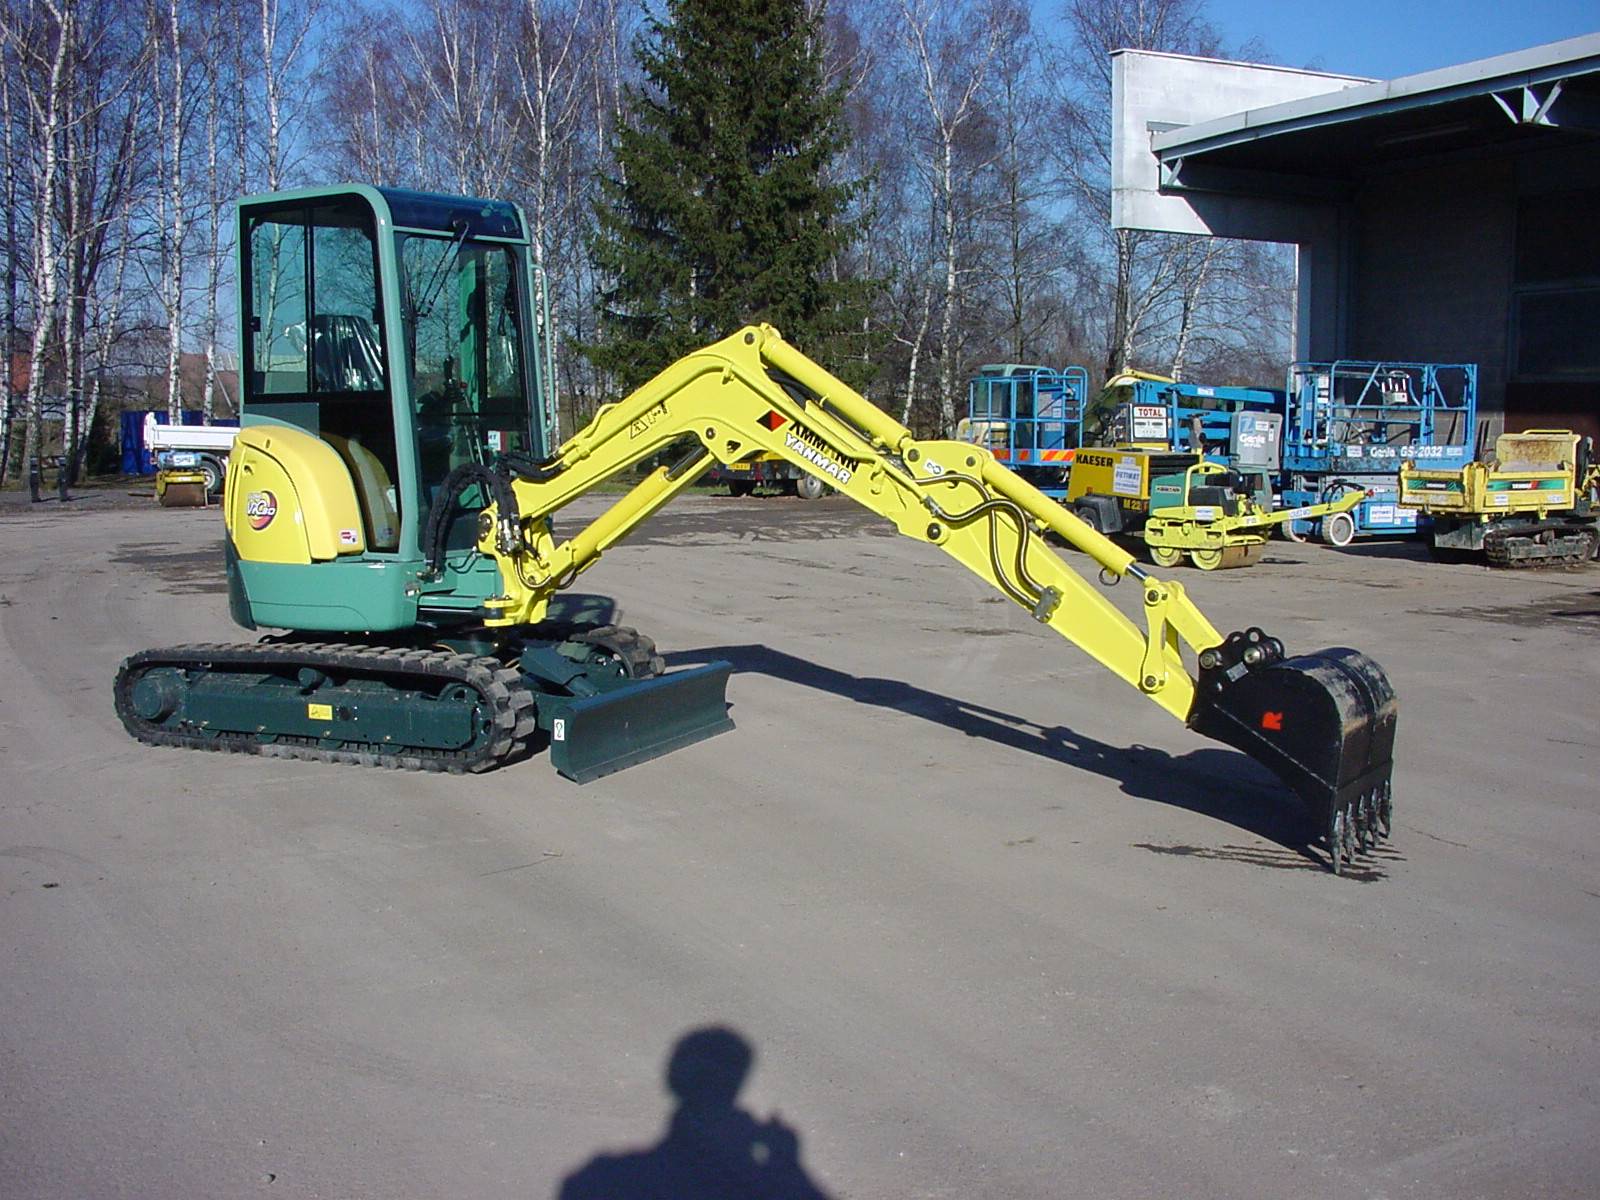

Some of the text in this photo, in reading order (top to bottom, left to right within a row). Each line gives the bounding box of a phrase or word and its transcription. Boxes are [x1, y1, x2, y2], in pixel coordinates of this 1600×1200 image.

[1138, 408, 1163, 417] TOTAL
[1370, 446, 1396, 457] Genie
[1400, 446, 1443, 457] GS-2032
[784, 431, 852, 485] YANMAR
[1076, 454, 1114, 467] KAESER
